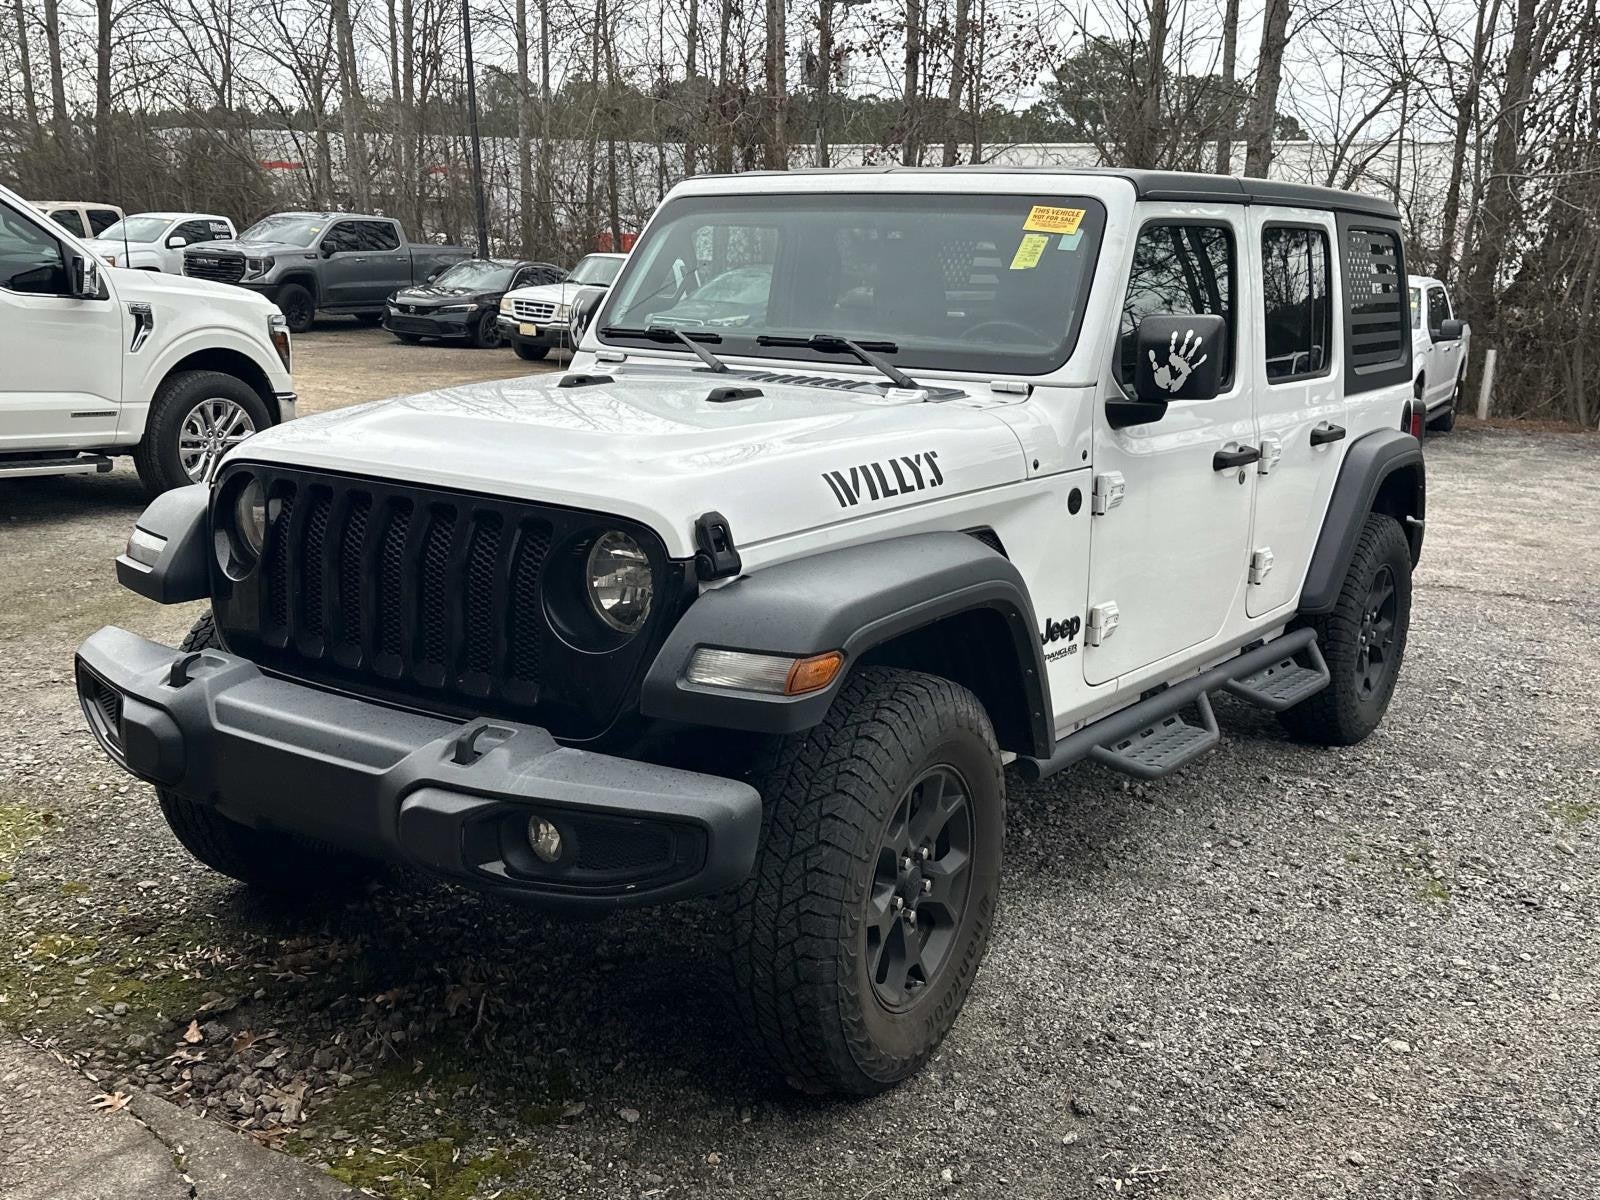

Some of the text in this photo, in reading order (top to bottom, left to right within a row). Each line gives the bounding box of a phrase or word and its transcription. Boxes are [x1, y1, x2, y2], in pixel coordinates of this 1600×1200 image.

[1052, 209, 1081, 217] VEHICLE
[821, 451, 944, 507] WILLYS
[1040, 616, 1080, 645] Jeep
[1044, 644, 1077, 660] RANGLER
